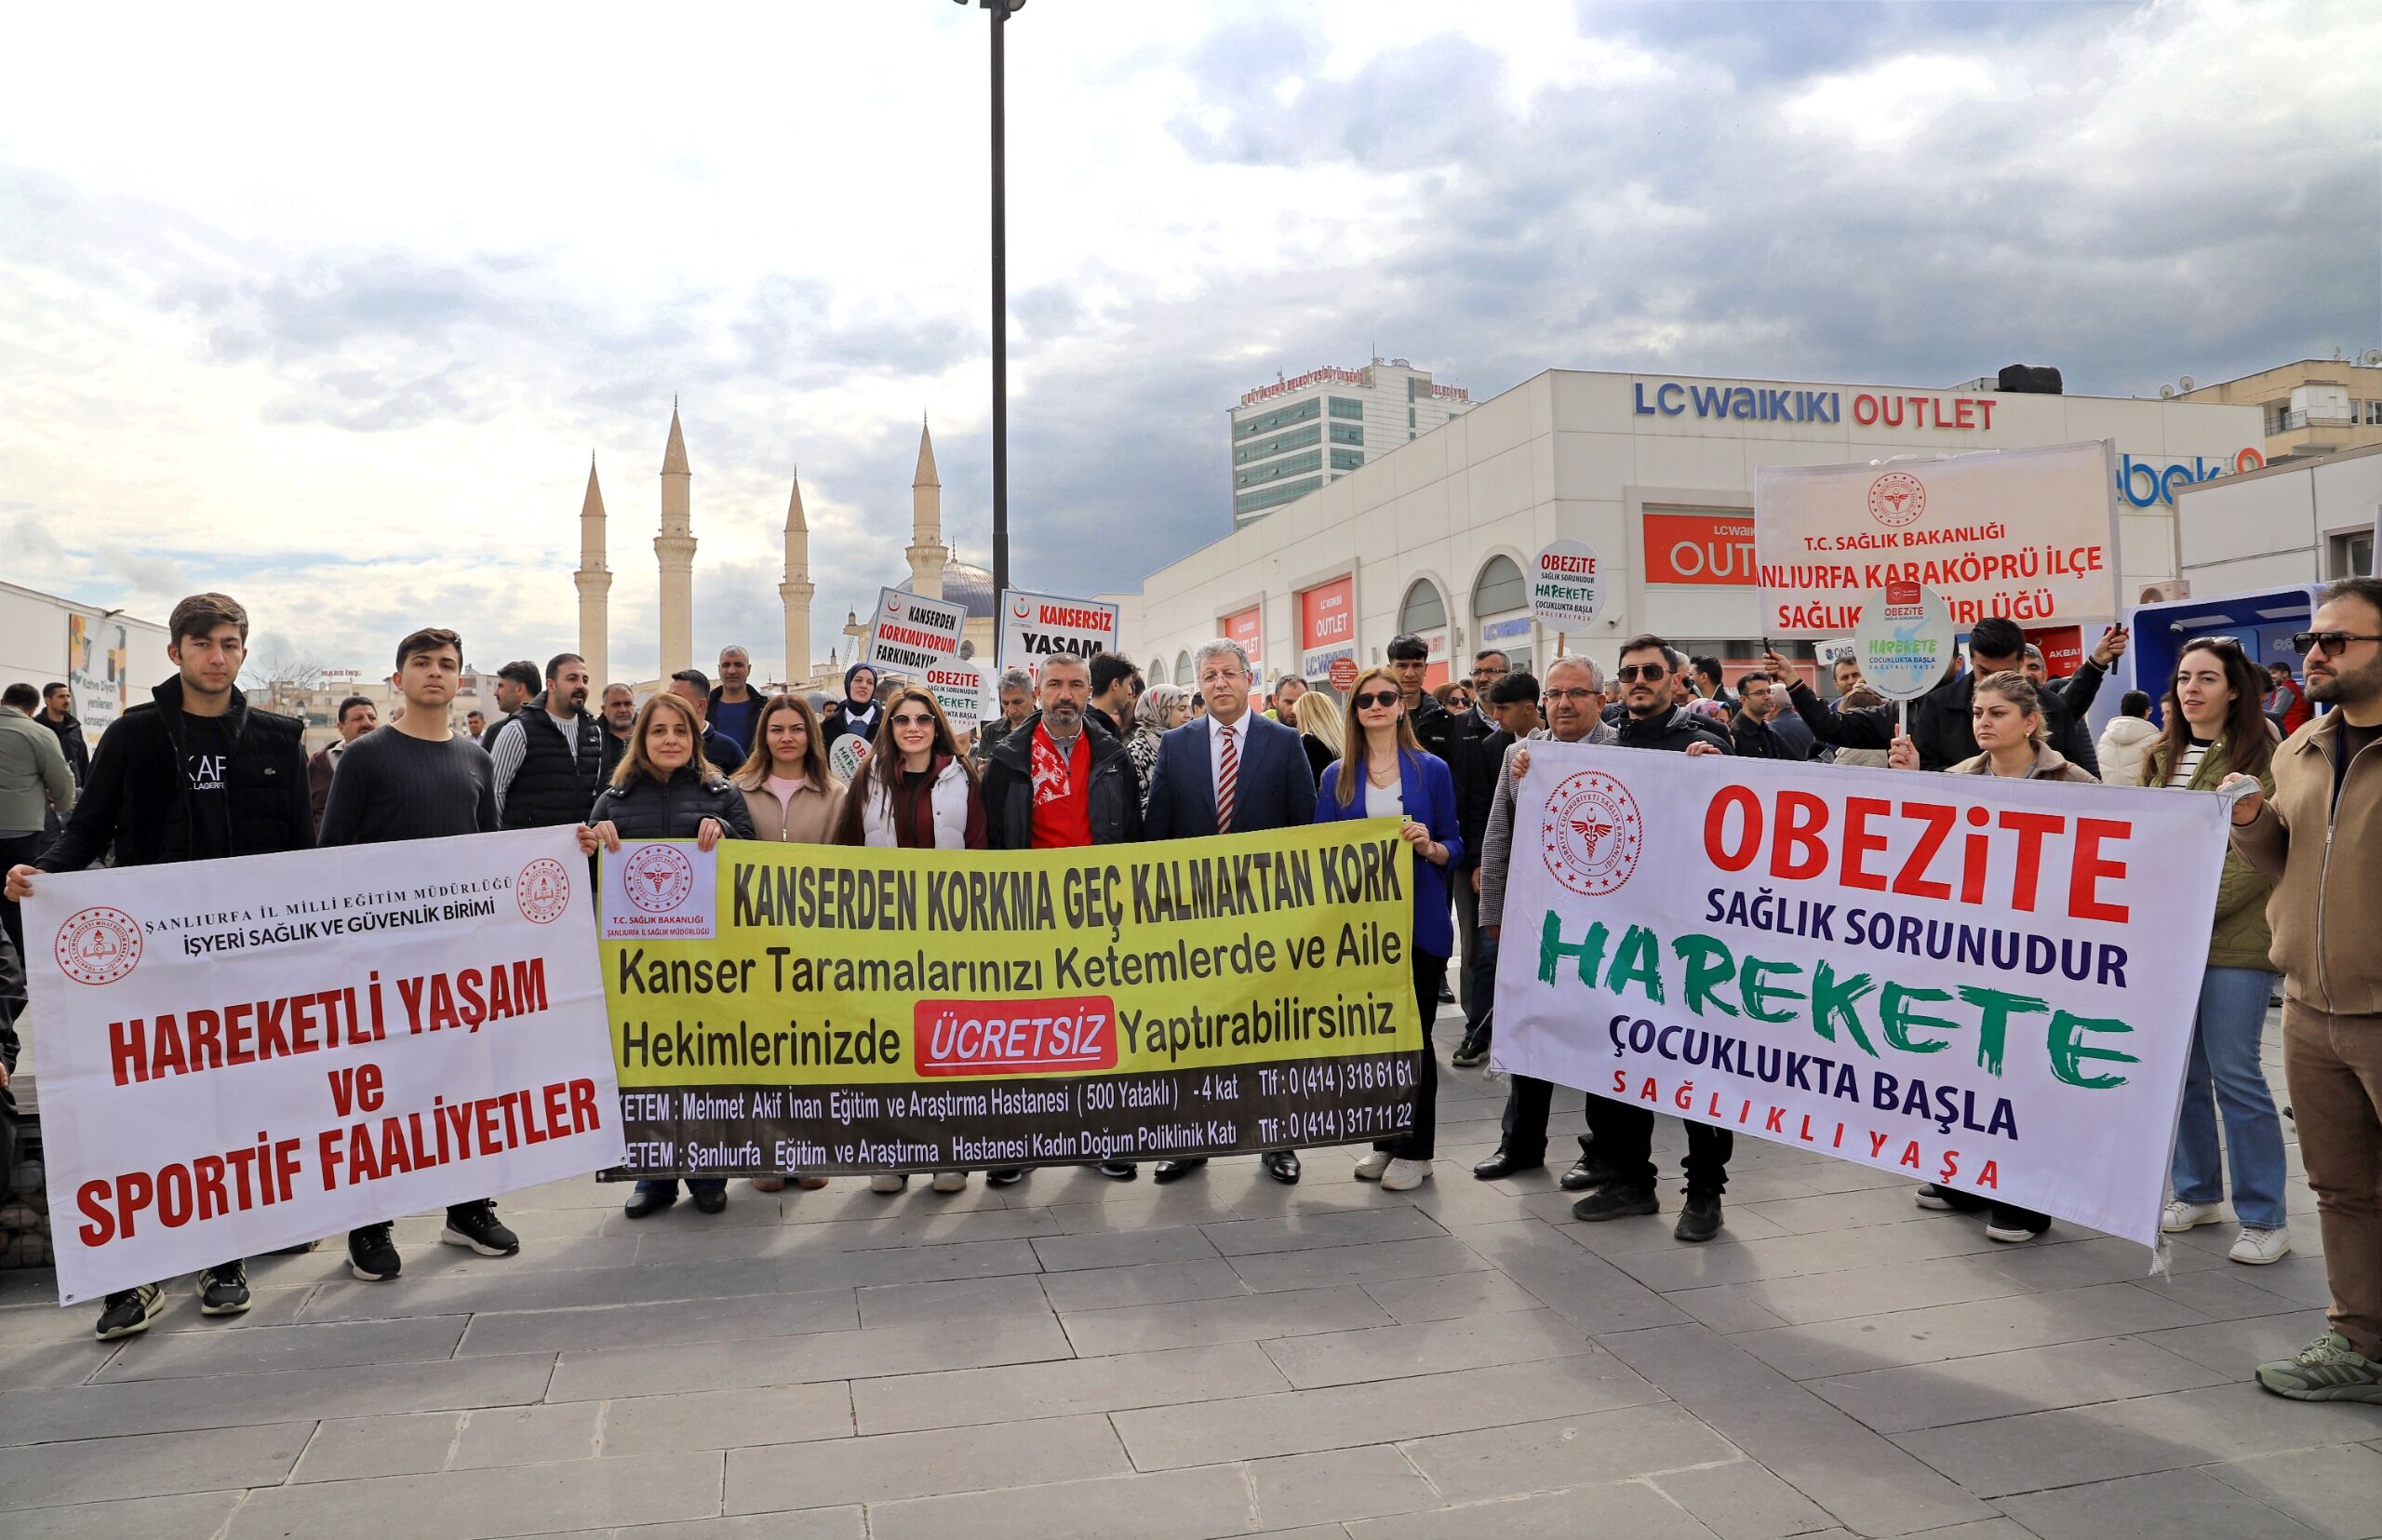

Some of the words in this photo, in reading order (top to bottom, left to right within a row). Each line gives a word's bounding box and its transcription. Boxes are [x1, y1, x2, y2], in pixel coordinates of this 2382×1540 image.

[1853, 394, 1997, 430] OUTLET
[1804, 537, 1832, 552] T.C.
[1837, 531, 1899, 551] SAĞLIK
[1904, 522, 2005, 548] BAKANLIĞI
[1541, 571, 1559, 581] SAĞLIK
[1865, 547, 2039, 589] KARAKÖPRÜ
[2046, 545, 2104, 580] İLÇE
[1535, 583, 1594, 601] HAREKETE
[908, 606, 957, 631] KANSERDEN
[1039, 605, 1113, 632] KANSERSİZ
[1317, 612, 1347, 637] OUTLET
[1574, 606, 1593, 614] BAŞLA
[1778, 600, 1863, 629] SAĞLIK
[878, 623, 956, 654] KORKMUYORUM
[1834, 646, 1854, 659] QNB
[1868, 639, 1938, 655] HAREKETE
[937, 695, 979, 709] REKETE
[1560, 794, 1599, 826] CUMHURİYETİ
[1600, 797, 1621, 823] SAĞLIK
[1559, 830, 1575, 865] TÜRKİYE
[1604, 825, 1623, 869] BAKANLIĞI
[145, 910, 252, 934] ŞANLIURFA
[261, 905, 278, 919] İL
[287, 896, 338, 915] MİLLİ
[343, 889, 407, 909] EĞİTİM
[414, 877, 514, 899] MÜDÜRLÜĞÜ
[733, 863, 916, 931] KANSERDEN
[928, 871, 1056, 931] KORKMA
[1064, 865, 1123, 943] GEÇ
[1131, 850, 1313, 925] KALMAKTAN
[1319, 838, 1402, 904] KORK
[183, 929, 245, 957] İŞYERİ
[249, 921, 319, 946] SAĞLIK
[321, 916, 344, 934] VE
[347, 905, 440, 932] GÜVENLİK
[443, 896, 496, 919] BİRİMİ
[608, 930, 639, 938] ŞANLIURFA
[629, 916, 656, 924] SAĞLIK
[658, 916, 703, 924] BAKANLIĞI
[1706, 886, 1838, 943] SAĞLIK
[1844, 908, 2128, 988] SORUNUDUR
[620, 947, 756, 995] Kanser
[766, 946, 1042, 993] Taramalarınızı
[1055, 932, 1276, 989] Ketemlerde
[1286, 935, 1325, 971] ve
[1336, 921, 1401, 967] Aile
[1538, 908, 2142, 1090] HAREKETE
[108, 970, 385, 1086] HAREKETLİ
[396, 957, 549, 1033] YAŞAM
[622, 1018, 901, 1068] Hekimlerinizde
[931, 1006, 1106, 1060] ÜCRETSİZ
[1119, 992, 1396, 1063] Yaptırabilirsiniz
[328, 1063, 383, 1117] ve
[1609, 1014, 1859, 1104] ÇOCUKLUKTA
[1873, 1070, 2019, 1142] BAŞLA
[621, 1093, 670, 1122] ETEM
[683, 1091, 744, 1120] Mehmet
[752, 1091, 782, 1119] Akif
[789, 1086, 822, 1119] İnan
[830, 1089, 878, 1125] Eğitim
[887, 1097, 905, 1118] ve
[909, 1090, 987, 1122] Araştırma
[991, 1085, 1069, 1116] Hastanesi
[1216, 1073, 1238, 1101] kat
[75, 1131, 302, 1247] SPORTİF
[319, 1078, 601, 1192] FAALİYETLER
[624, 1142, 673, 1169] ETEM
[688, 1141, 761, 1172] Şanlıurfa
[775, 1138, 826, 1172] Eğitim
[835, 1144, 854, 1164] ve
[858, 1138, 939, 1168] Araştırma
[953, 1133, 1027, 1161] Hastanesi
[1033, 1132, 1076, 1158] Kadın
[1081, 1127, 1133, 1159] Doğum
[1138, 1120, 1203, 1152] Poliklinik
[1208, 1119, 1236, 1145] Katı
